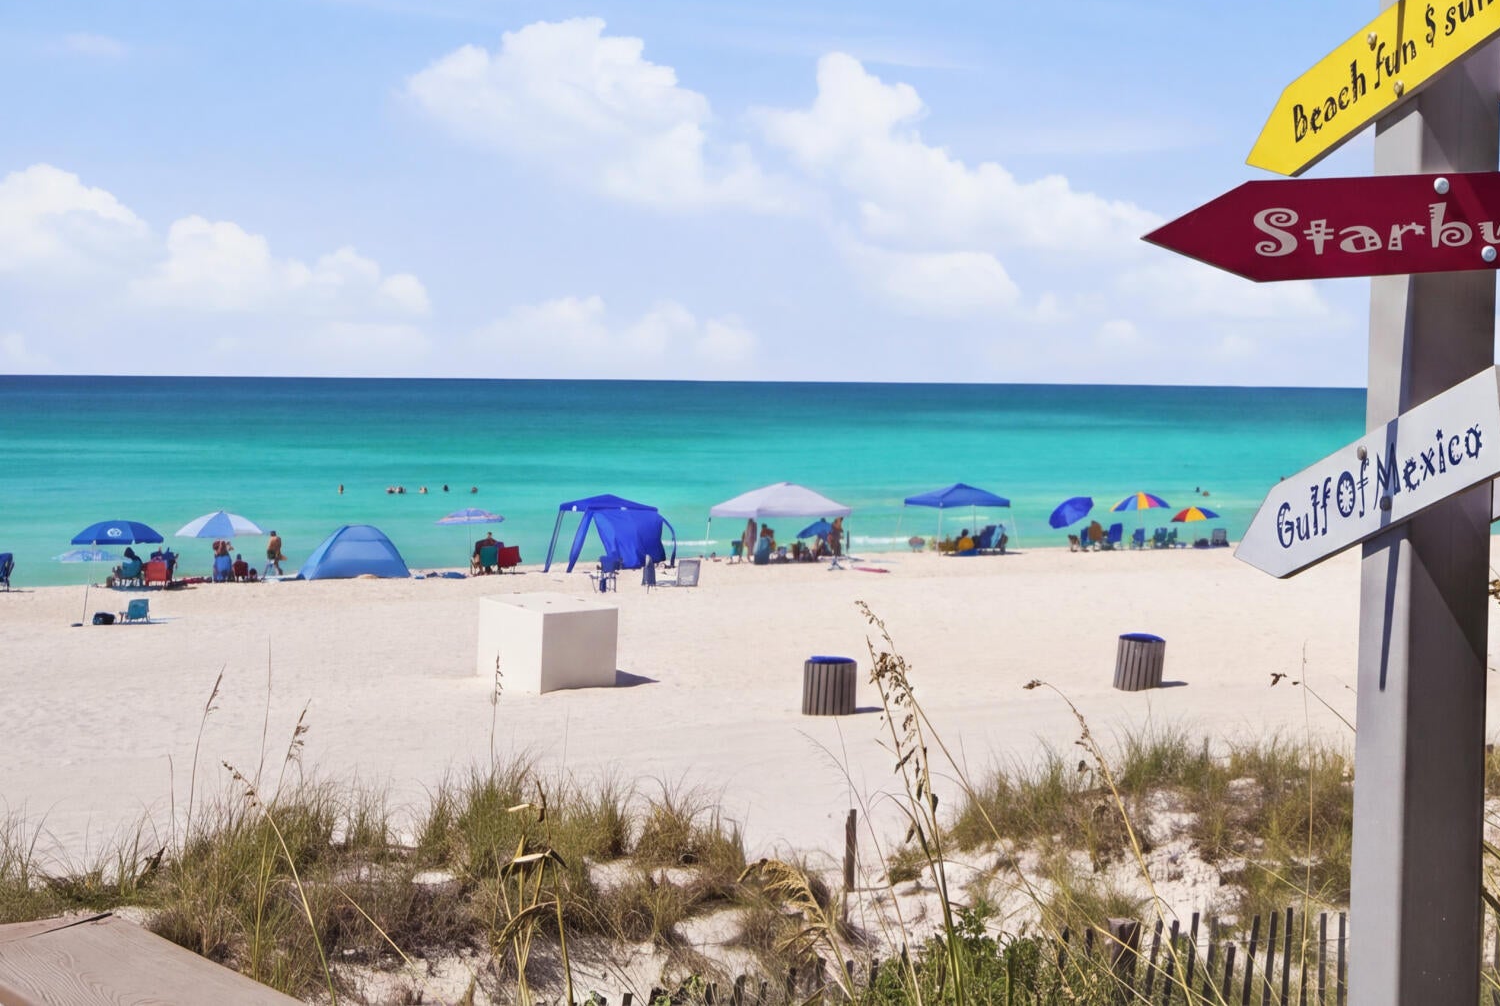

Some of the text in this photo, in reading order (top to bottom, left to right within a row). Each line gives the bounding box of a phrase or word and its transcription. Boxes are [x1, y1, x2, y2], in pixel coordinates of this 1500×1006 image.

[1293, 59, 1367, 143] Beach
[1374, 42, 1417, 89] fun
[1277, 423, 1482, 548] Gulf Of Mexico
